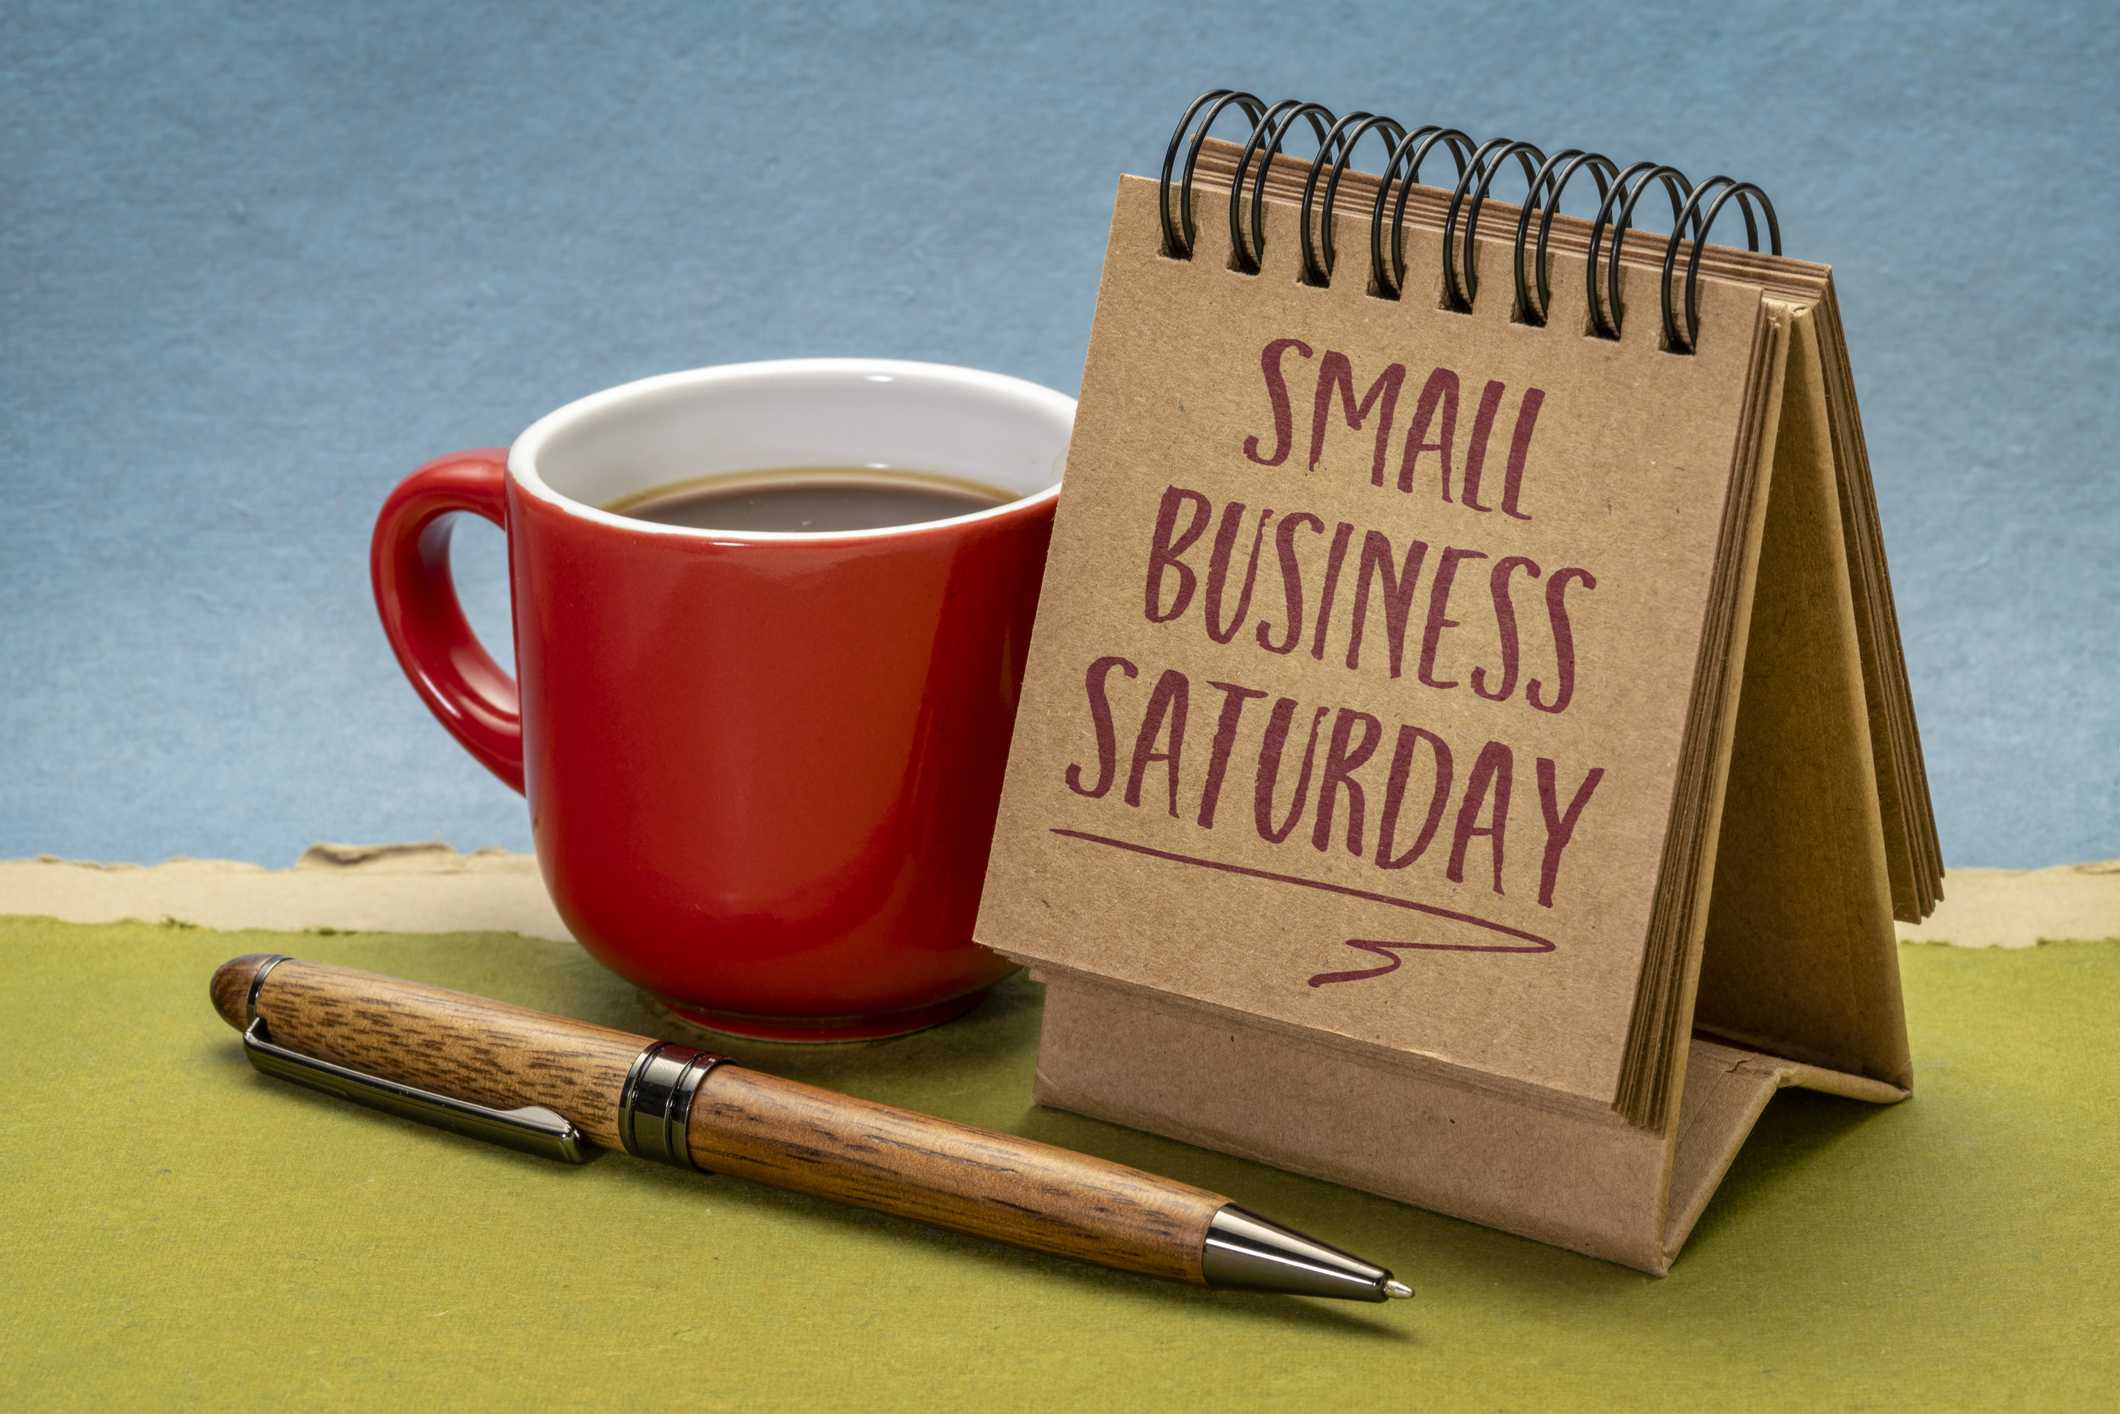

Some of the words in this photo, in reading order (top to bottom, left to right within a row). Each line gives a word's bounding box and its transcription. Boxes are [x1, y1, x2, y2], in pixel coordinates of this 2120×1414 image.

[1243, 338, 1546, 521] SMALL
[1144, 485, 1598, 714] BUSINESS
[1064, 656, 1605, 909] SATURDAY
